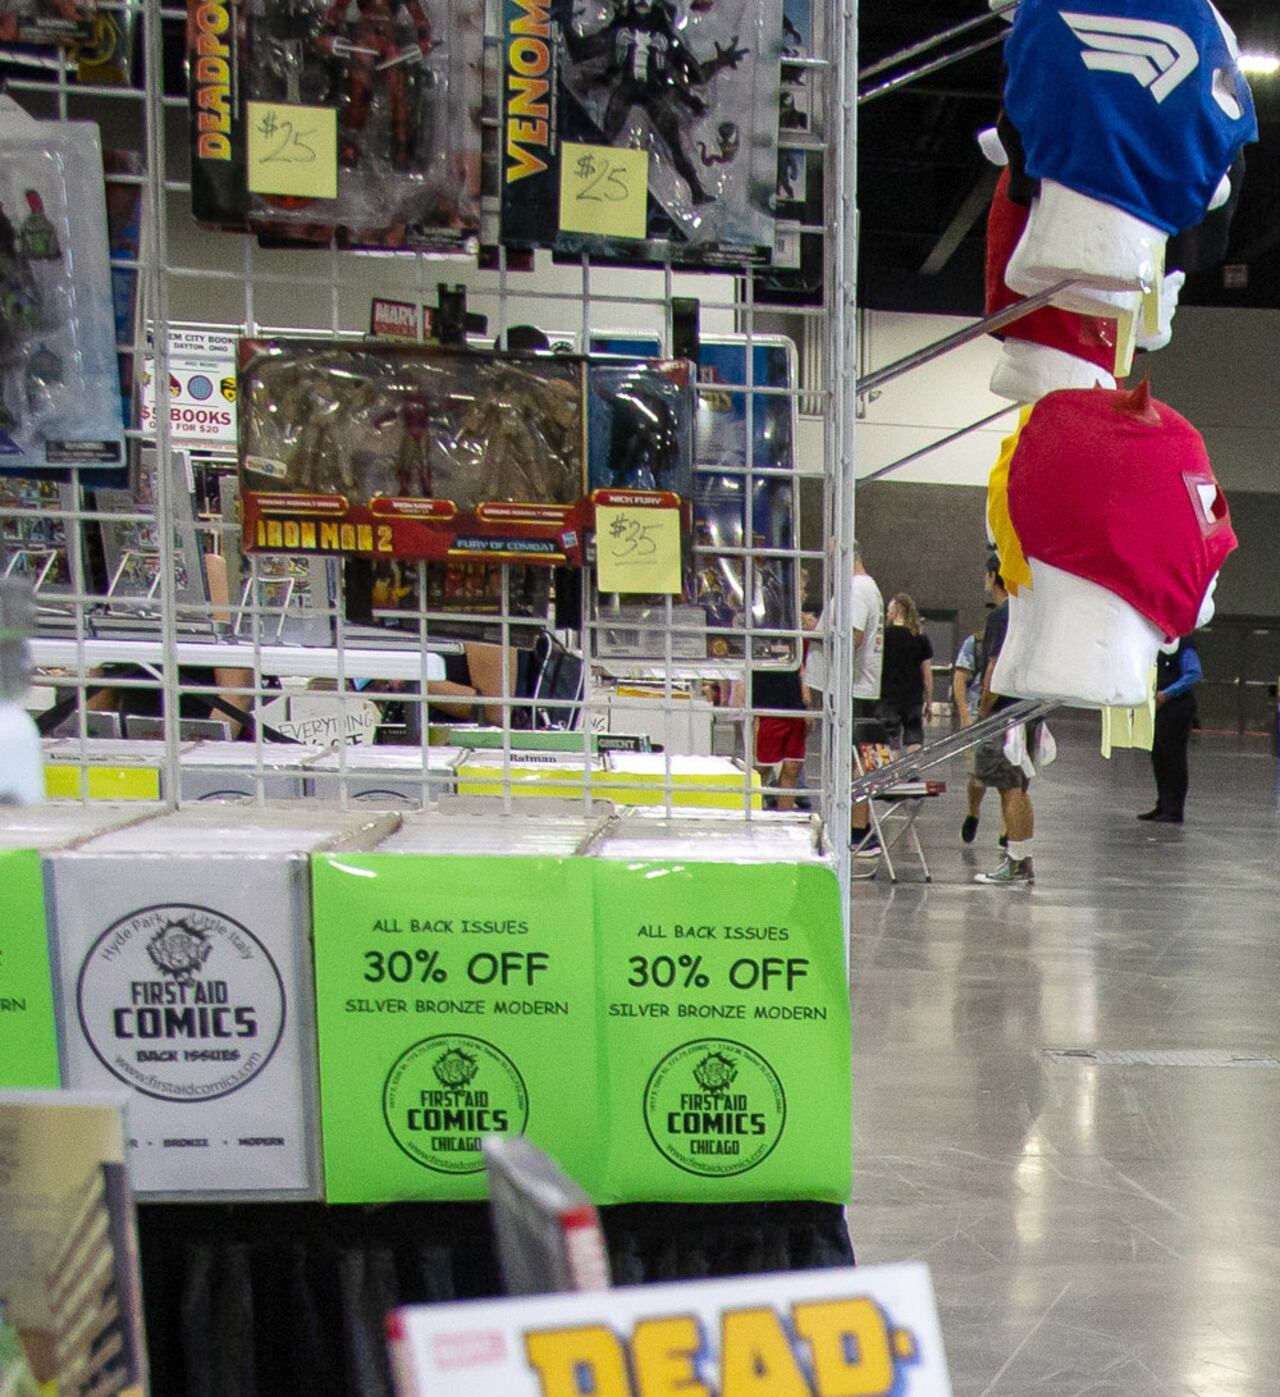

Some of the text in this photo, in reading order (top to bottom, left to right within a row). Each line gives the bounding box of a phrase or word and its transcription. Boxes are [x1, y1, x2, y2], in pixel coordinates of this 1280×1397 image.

[197, 0, 231, 161] DEADPO
[507, 0, 551, 184] VENOM
[257, 110, 317, 164] $25
[573, 153, 630, 202] $25
[375, 301, 433, 329] MARVL
[170, 407, 232, 426] BOOKS
[257, 519, 393, 552] IRON MAN 2
[456, 538, 557, 553] FURY OF COMBAT
[608, 511, 664, 558] $35
[100, 912, 255, 963] Hyde Park Little Italy
[373, 919, 529, 934] ALL BACK ISSUES
[637, 925, 789, 941] ALL BACK ISSUES
[363, 948, 550, 986] 30% OFF
[627, 954, 810, 991] 30% OFF
[131, 980, 229, 1006] FIRST AID
[345, 999, 569, 1016] SILVER BRONZE MODERN
[608, 1003, 828, 1020] SILVER BRONZE MODERN
[113, 1006, 258, 1038] COMICS
[136, 1050, 241, 1063] BACK ISSUES
[420, 1090, 489, 1108] FIRST AID
[680, 1093, 747, 1112] FIRST AID
[407, 1108, 509, 1132] COMICS
[667, 1111, 766, 1135] COMICS
[431, 1136, 482, 1152] CHICAGO
[690, 1139, 740, 1156] CHICAGO
